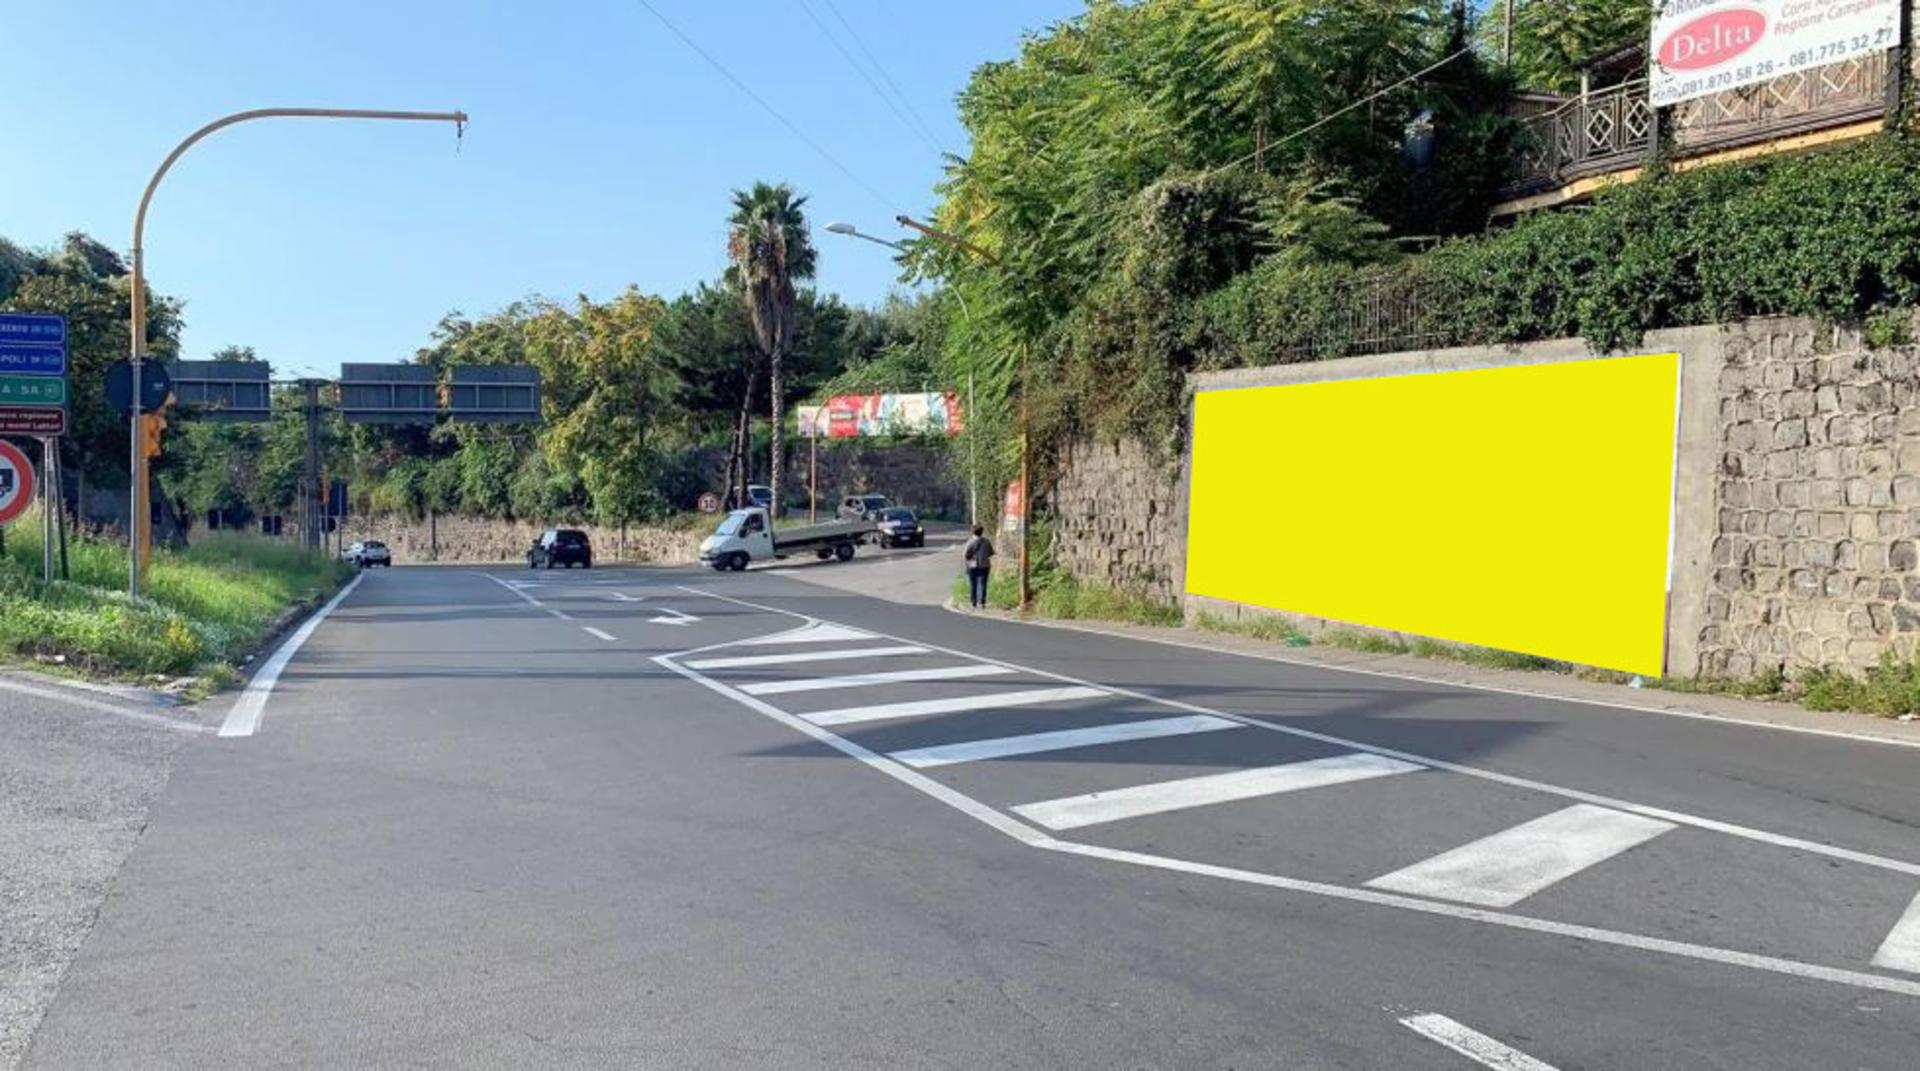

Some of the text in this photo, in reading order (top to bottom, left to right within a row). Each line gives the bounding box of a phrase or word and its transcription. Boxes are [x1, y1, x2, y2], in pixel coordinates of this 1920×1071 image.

[1672, 23, 1751, 63] Delta
[1774, 12, 1825, 36] Regione
[1736, 65, 1753, 81] 58
[1756, 60, 1774, 76] 26
[1851, 34, 1869, 51] 32
[1874, 27, 1893, 45] 27
